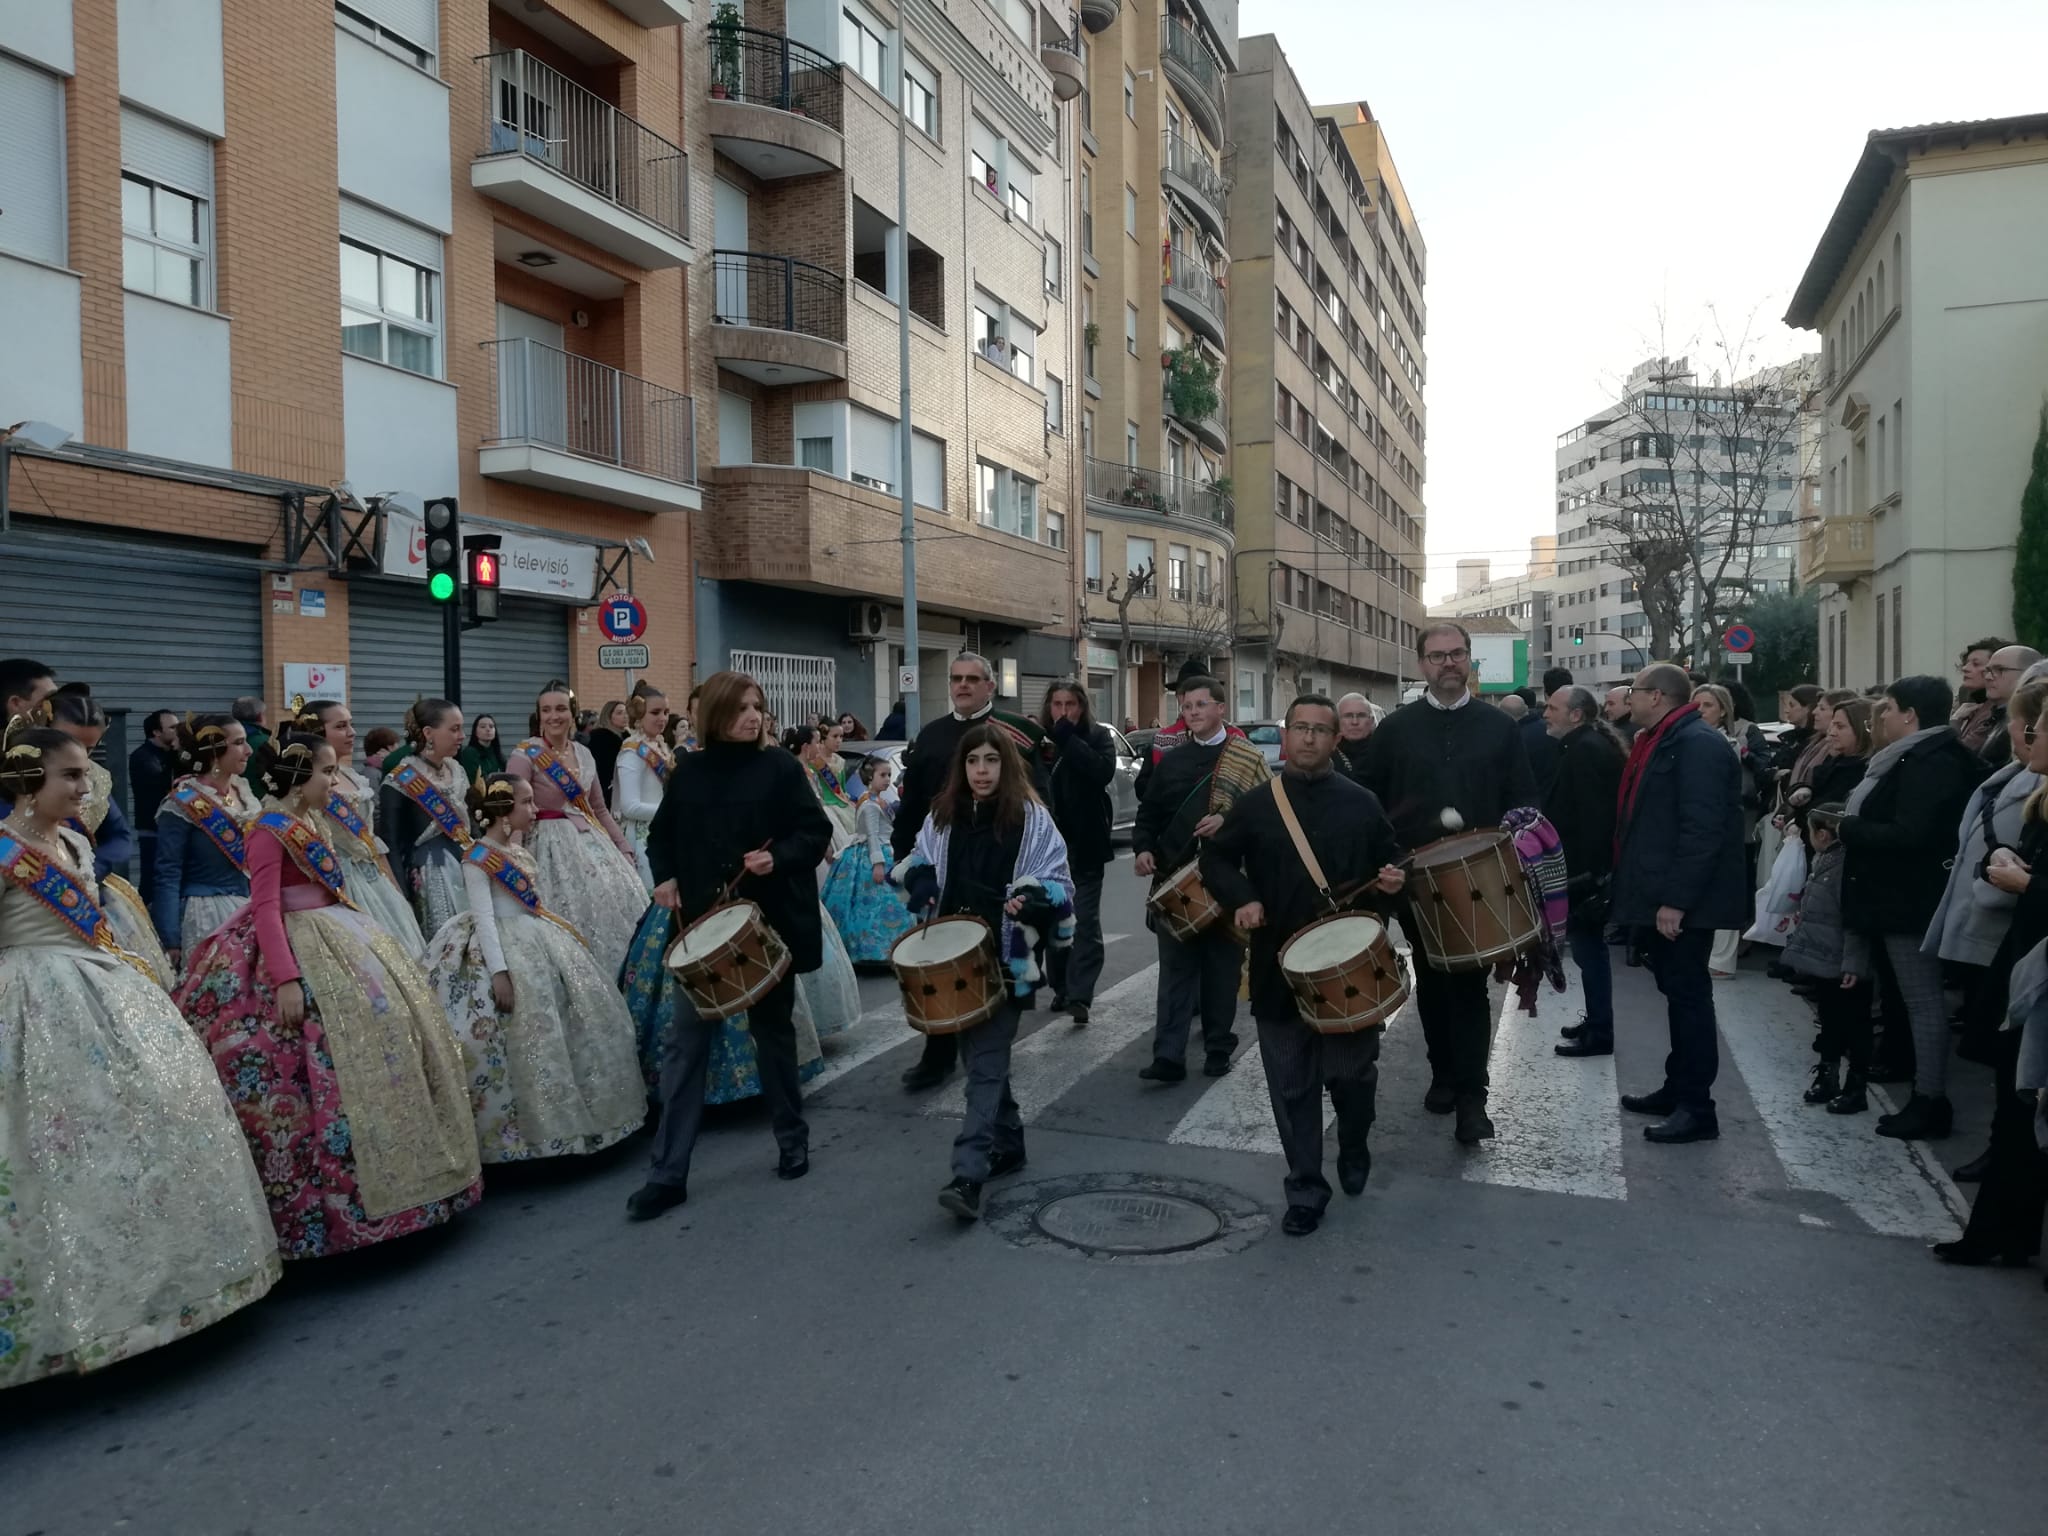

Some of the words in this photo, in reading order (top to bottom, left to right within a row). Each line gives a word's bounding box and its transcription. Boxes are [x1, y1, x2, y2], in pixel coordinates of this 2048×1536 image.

[514, 553, 569, 576] televisió
[608, 595, 634, 603] MOTOS
[617, 611, 628, 626] P
[612, 634, 636, 643] MOTOS
